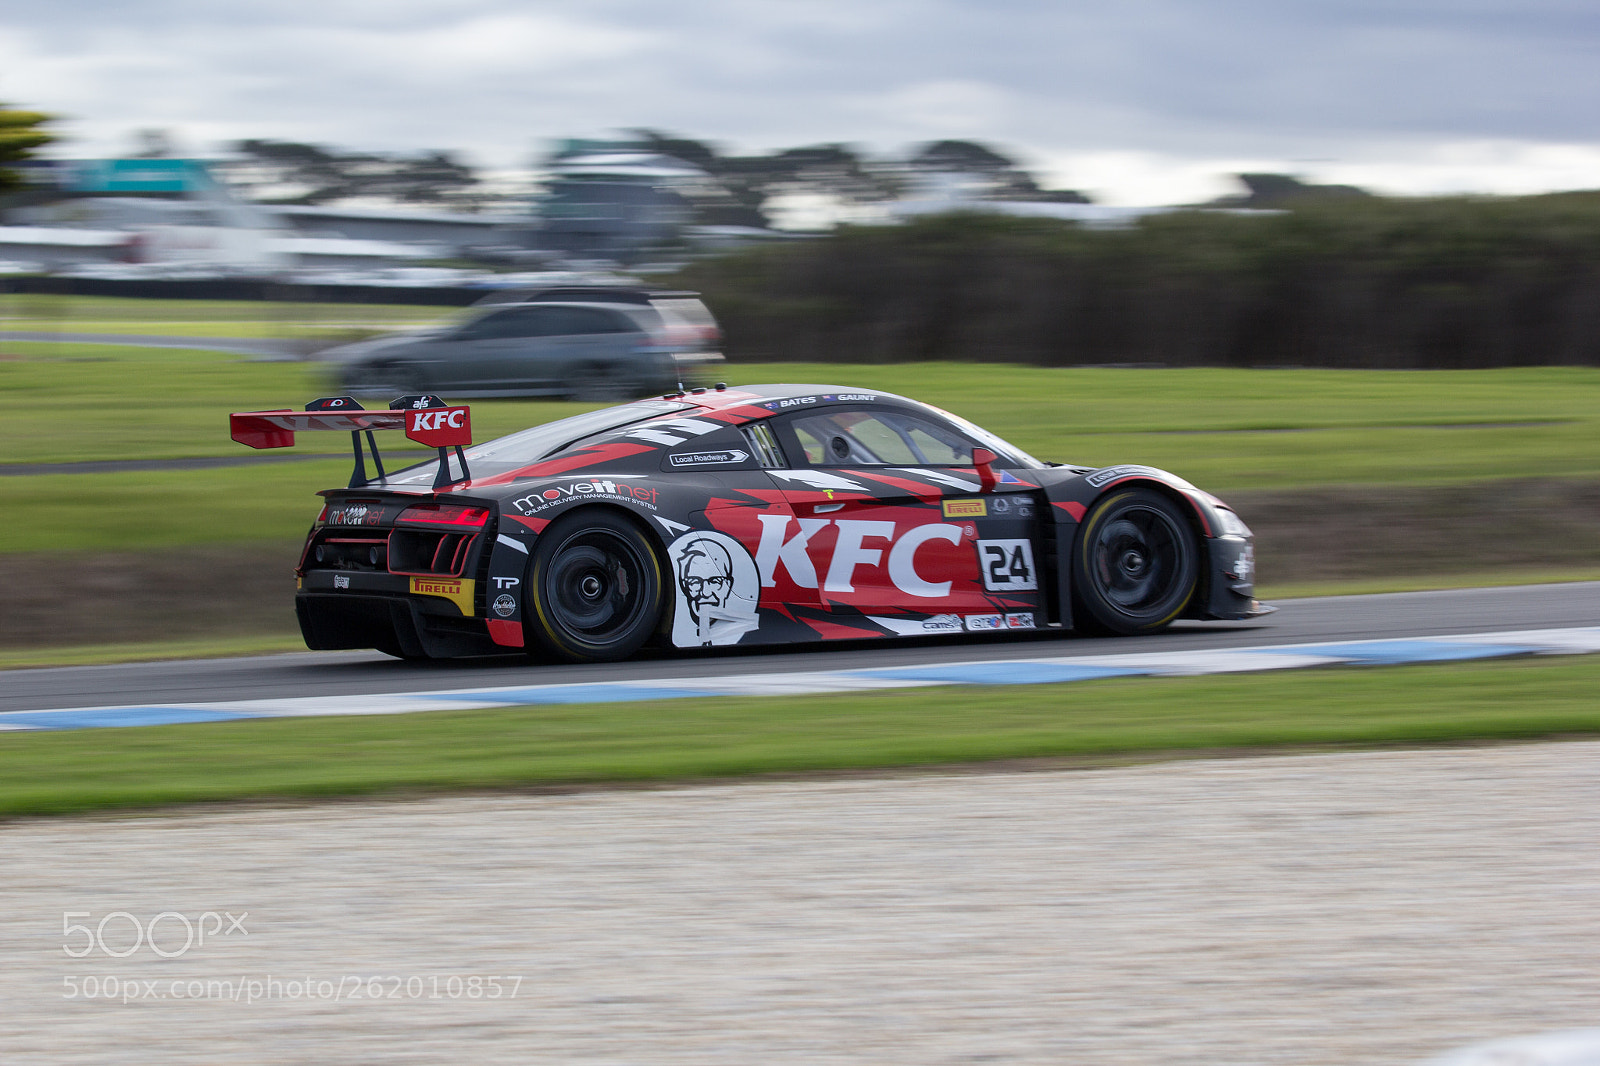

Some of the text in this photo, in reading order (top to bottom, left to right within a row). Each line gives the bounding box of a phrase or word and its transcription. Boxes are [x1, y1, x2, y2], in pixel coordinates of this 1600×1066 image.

[780, 396, 816, 408] BATES
[837, 394, 877, 402] GAUNT
[412, 410, 464, 431] KFC
[675, 454, 728, 464] Local Roadways
[525, 503, 549, 516] ONLINE
[550, 495, 582, 507] DELIVERY
[632, 497, 657, 510] SYSTEM
[947, 502, 982, 514] PIRELLI
[755, 514, 964, 597] KFC
[985, 545, 1029, 583] 24
[414, 578, 461, 594] PIRELLI
[492, 576, 519, 588] TP
